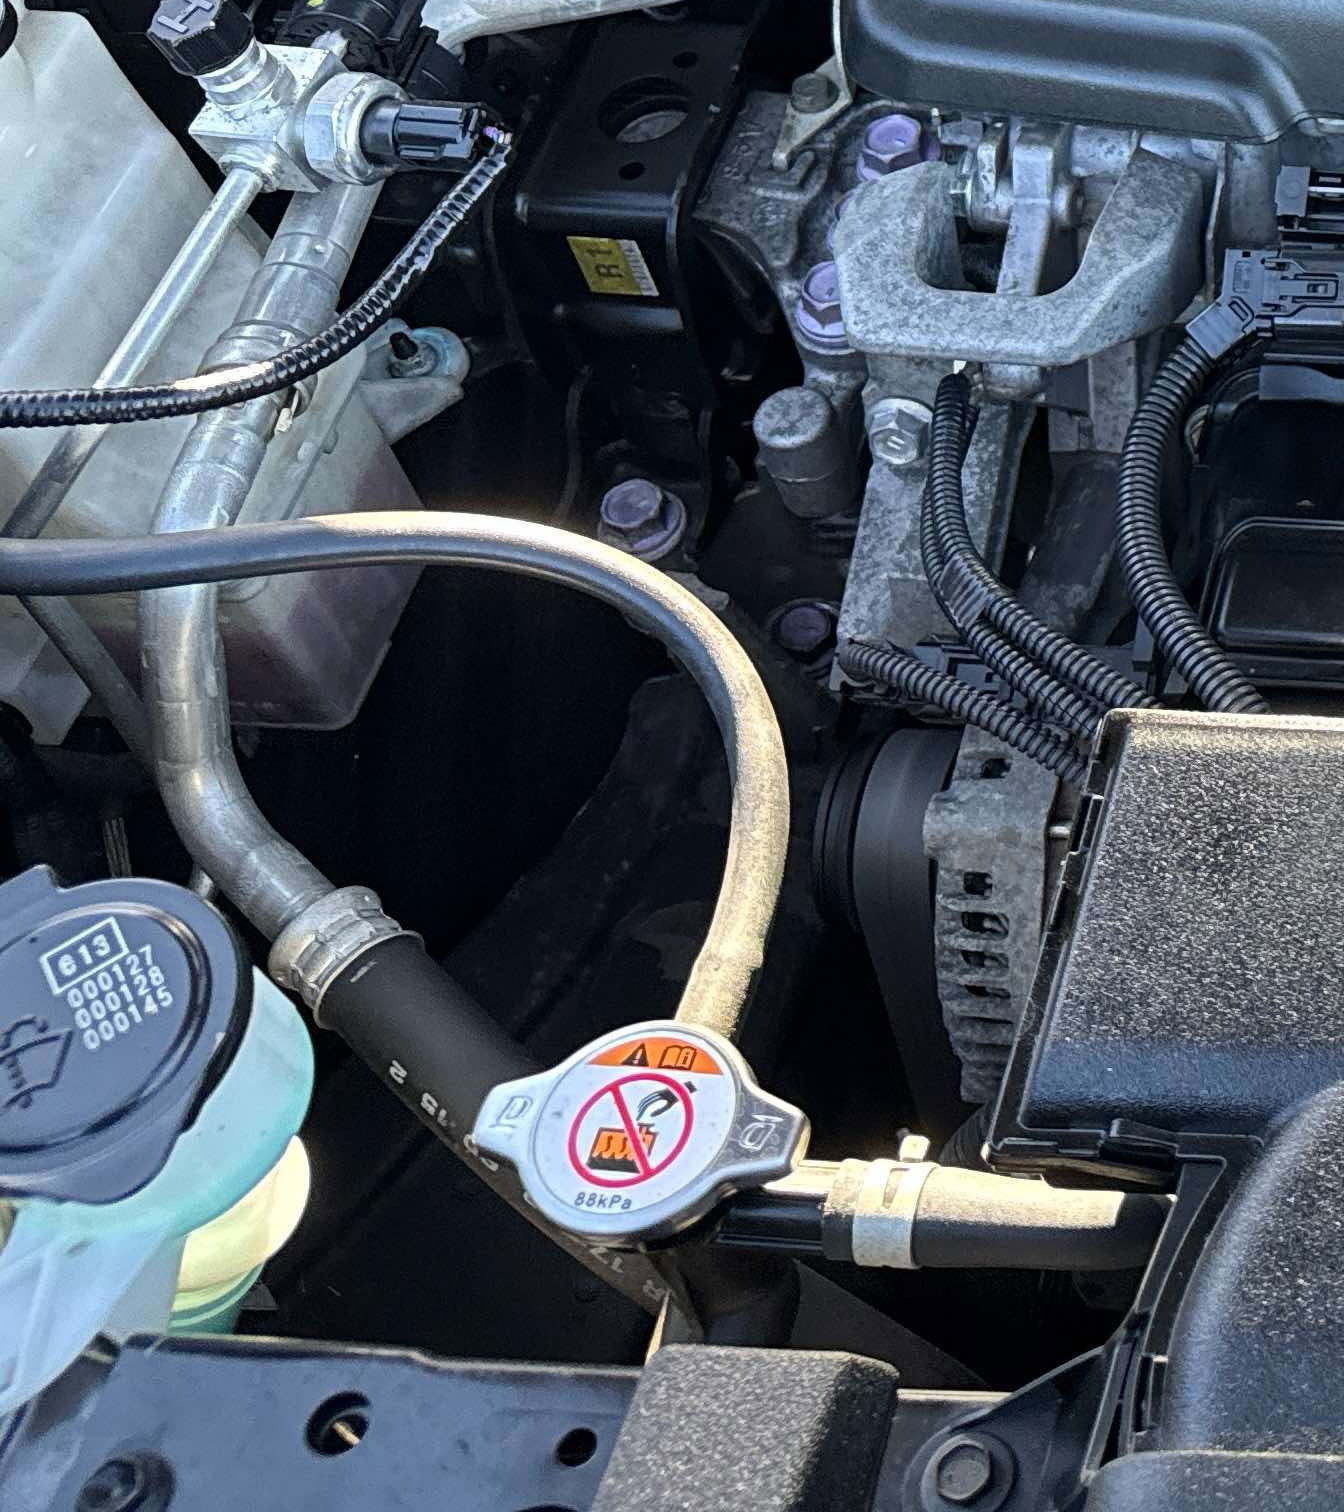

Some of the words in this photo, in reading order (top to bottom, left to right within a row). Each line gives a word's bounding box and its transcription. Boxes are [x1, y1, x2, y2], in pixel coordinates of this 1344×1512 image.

[58, 934, 111, 976] 613
[67, 943, 152, 1009] 000127
[75, 965, 165, 1029] 000128
[83, 985, 174, 1050] 000145
[574, 1191, 633, 1210] 88kPa
